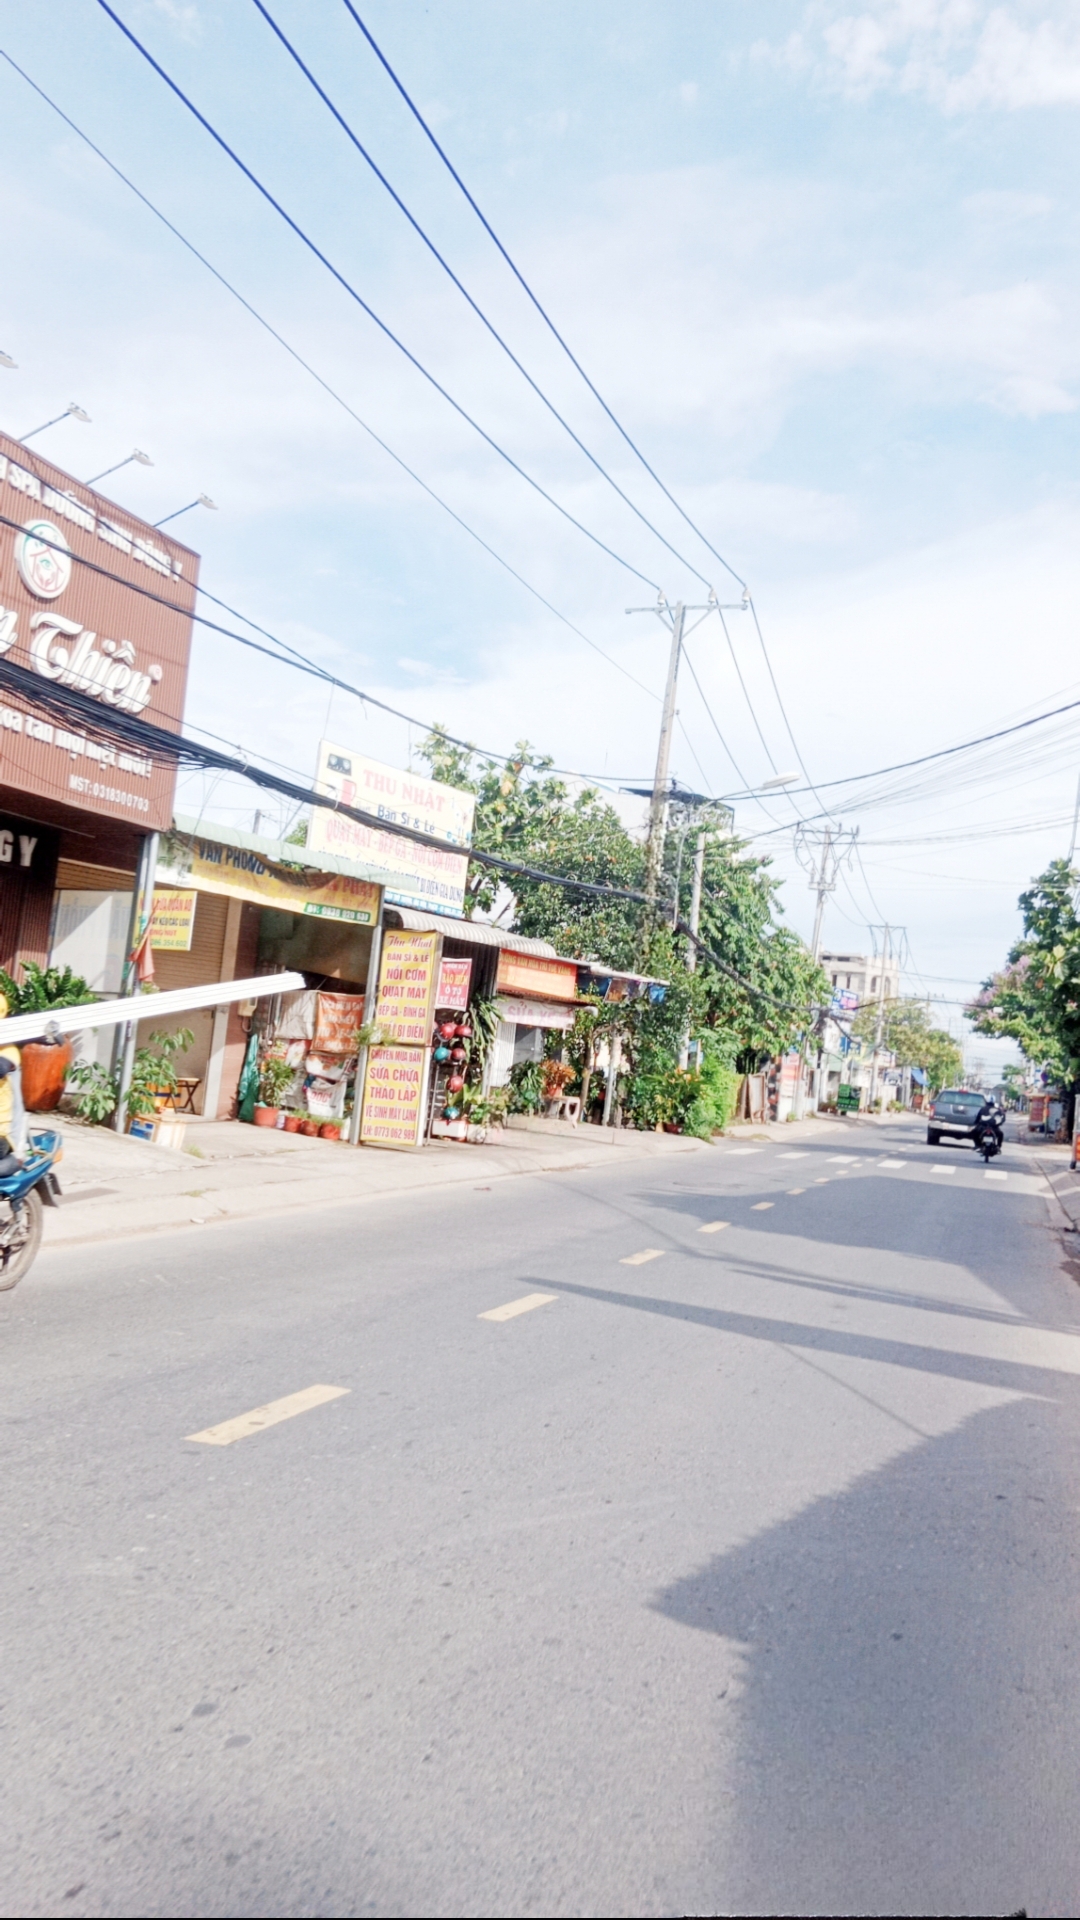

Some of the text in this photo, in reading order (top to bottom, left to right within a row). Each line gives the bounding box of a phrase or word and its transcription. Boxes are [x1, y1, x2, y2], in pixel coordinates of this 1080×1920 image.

[8, 462, 41, 501] SPA
[97, 515, 133, 556] SINH
[24, 711, 53, 744] tan
[363, 769, 445, 813] THU NHẬT
[405, 967, 427, 981] CƠM
[382, 985, 427, 999] QUẠT MÁY
[370, 1064, 389, 1080] SỬA
[392, 1067, 419, 1082] CHỮA
[374, 1105, 387, 1119] SINH
